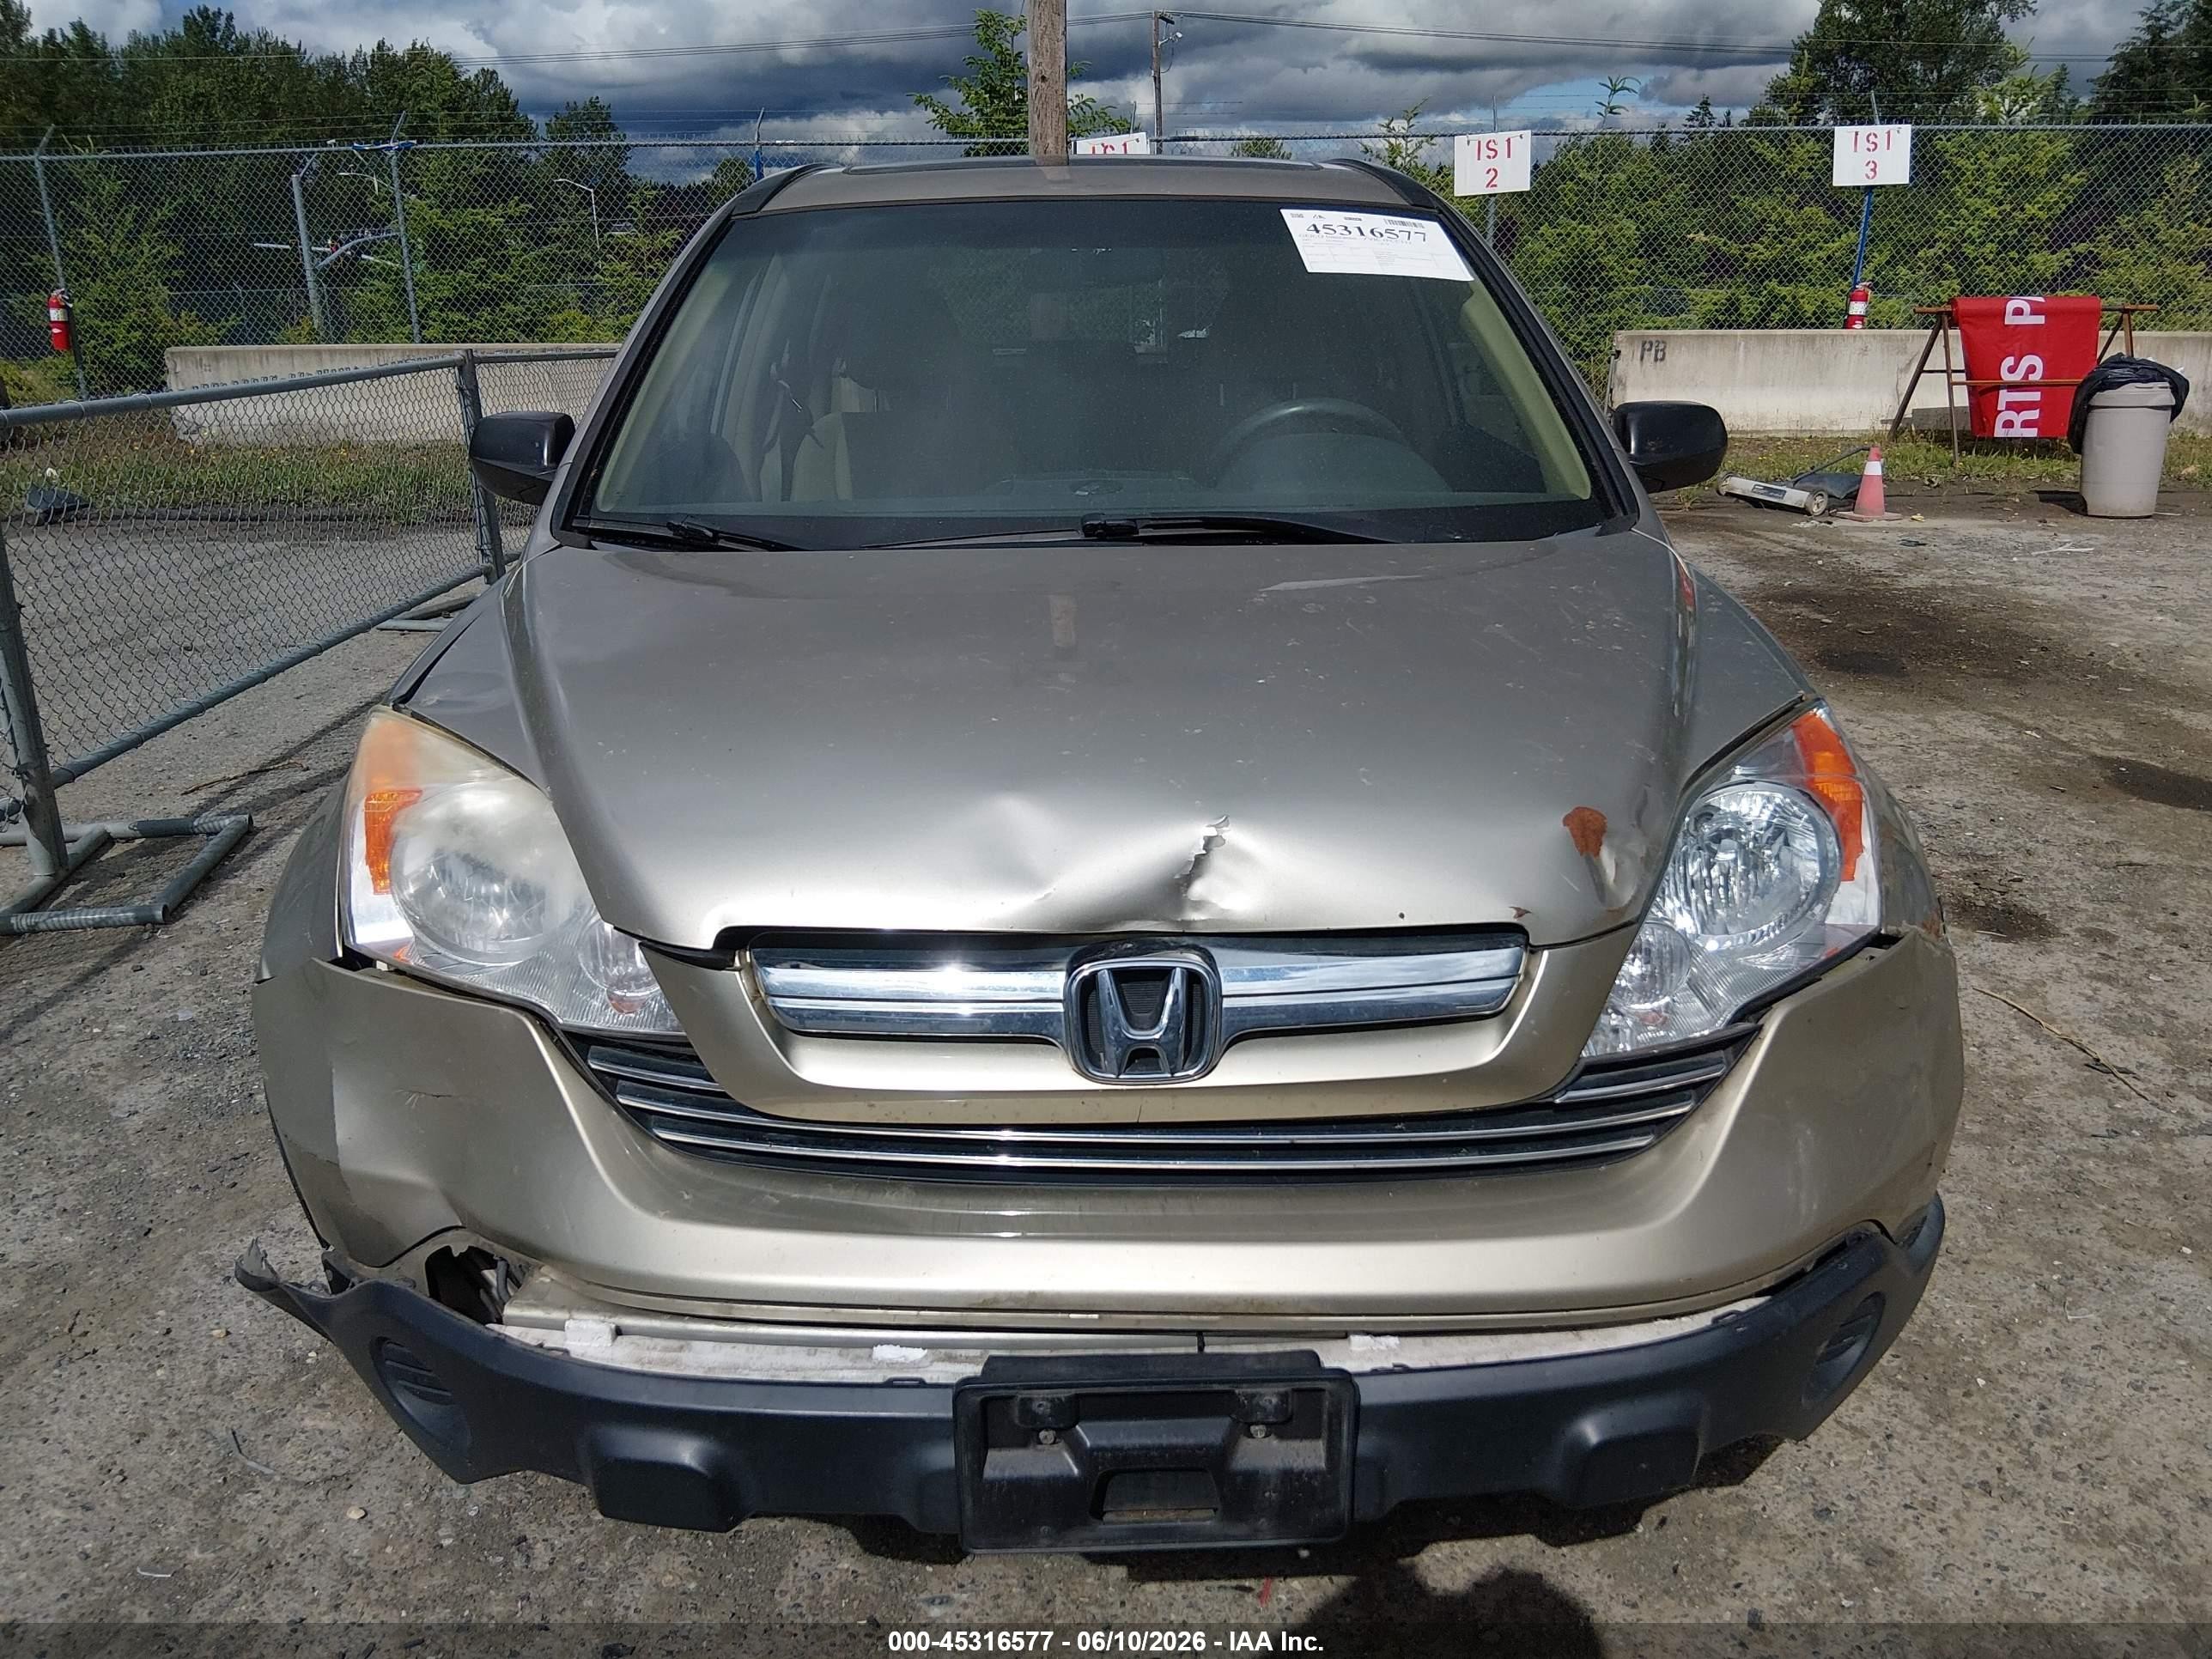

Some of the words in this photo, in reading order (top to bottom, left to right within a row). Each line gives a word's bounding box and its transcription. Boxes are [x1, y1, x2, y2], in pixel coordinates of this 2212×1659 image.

[1486, 167, 1498, 188] 2
[1865, 161, 1878, 179] 3
[1306, 223, 1427, 242] 45316577
[2004, 296, 2045, 325] P
[1639, 340, 1667, 362] PB
[1095, 966, 1189, 1079] H
